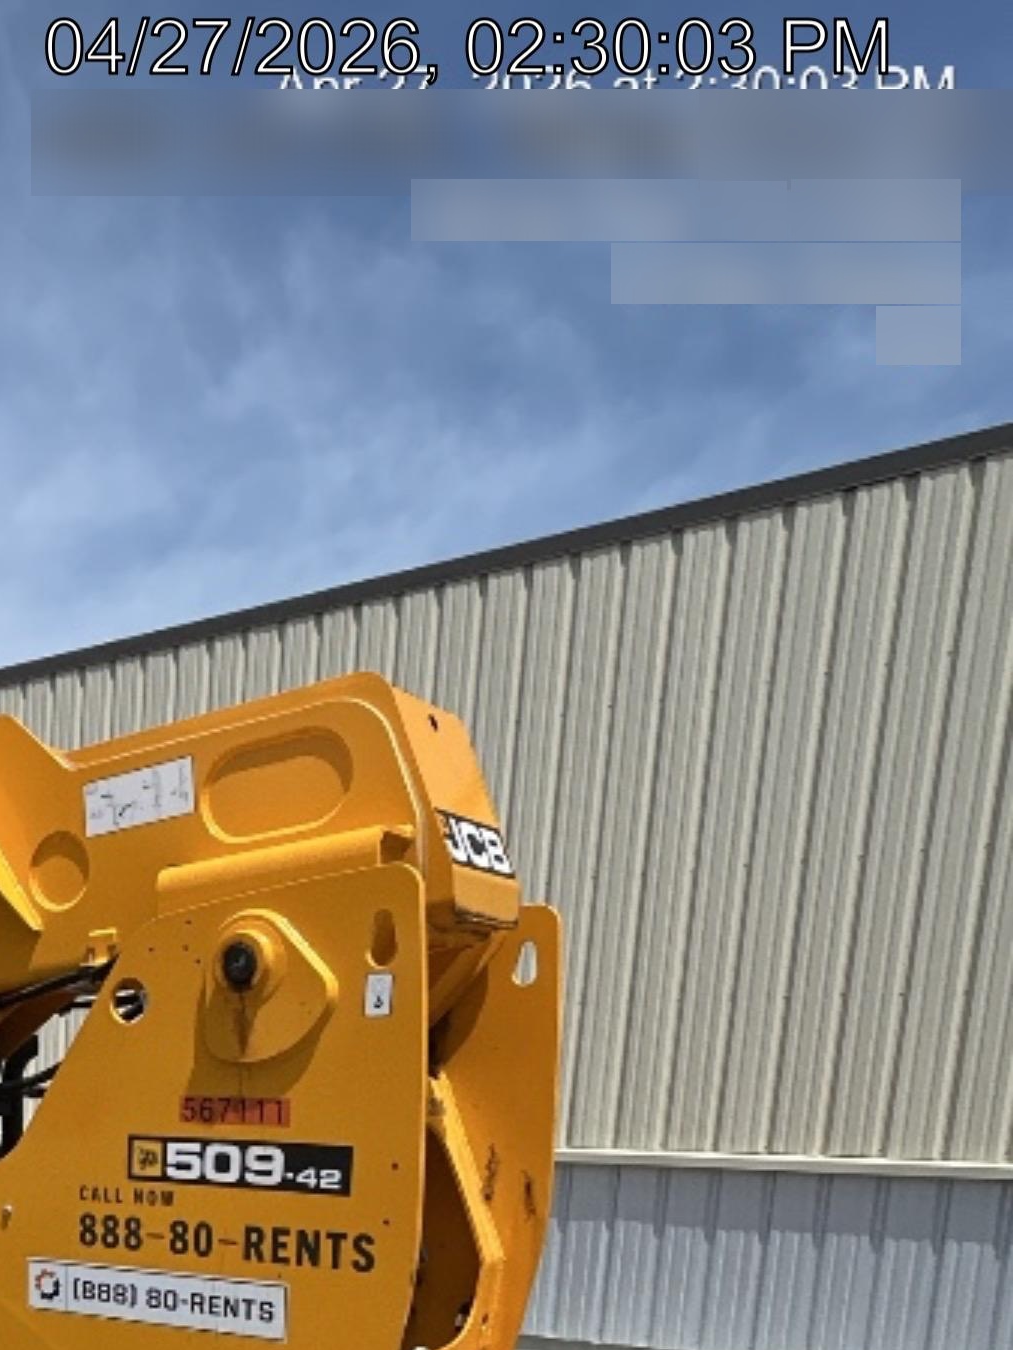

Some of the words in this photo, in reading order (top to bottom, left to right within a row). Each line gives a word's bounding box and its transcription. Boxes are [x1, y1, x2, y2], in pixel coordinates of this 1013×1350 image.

[444, 817, 514, 874] JCB
[181, 1096, 284, 1126] 567111
[165, 1142, 342, 1191] 509-42
[79, 1184, 124, 1204] CALL
[133, 1187, 175, 1207] NOW
[79, 1211, 376, 1273] 888-80-RENTS
[72, 1278, 138, 1309] (888)
[145, 1287, 275, 1323] 80-RENTS
